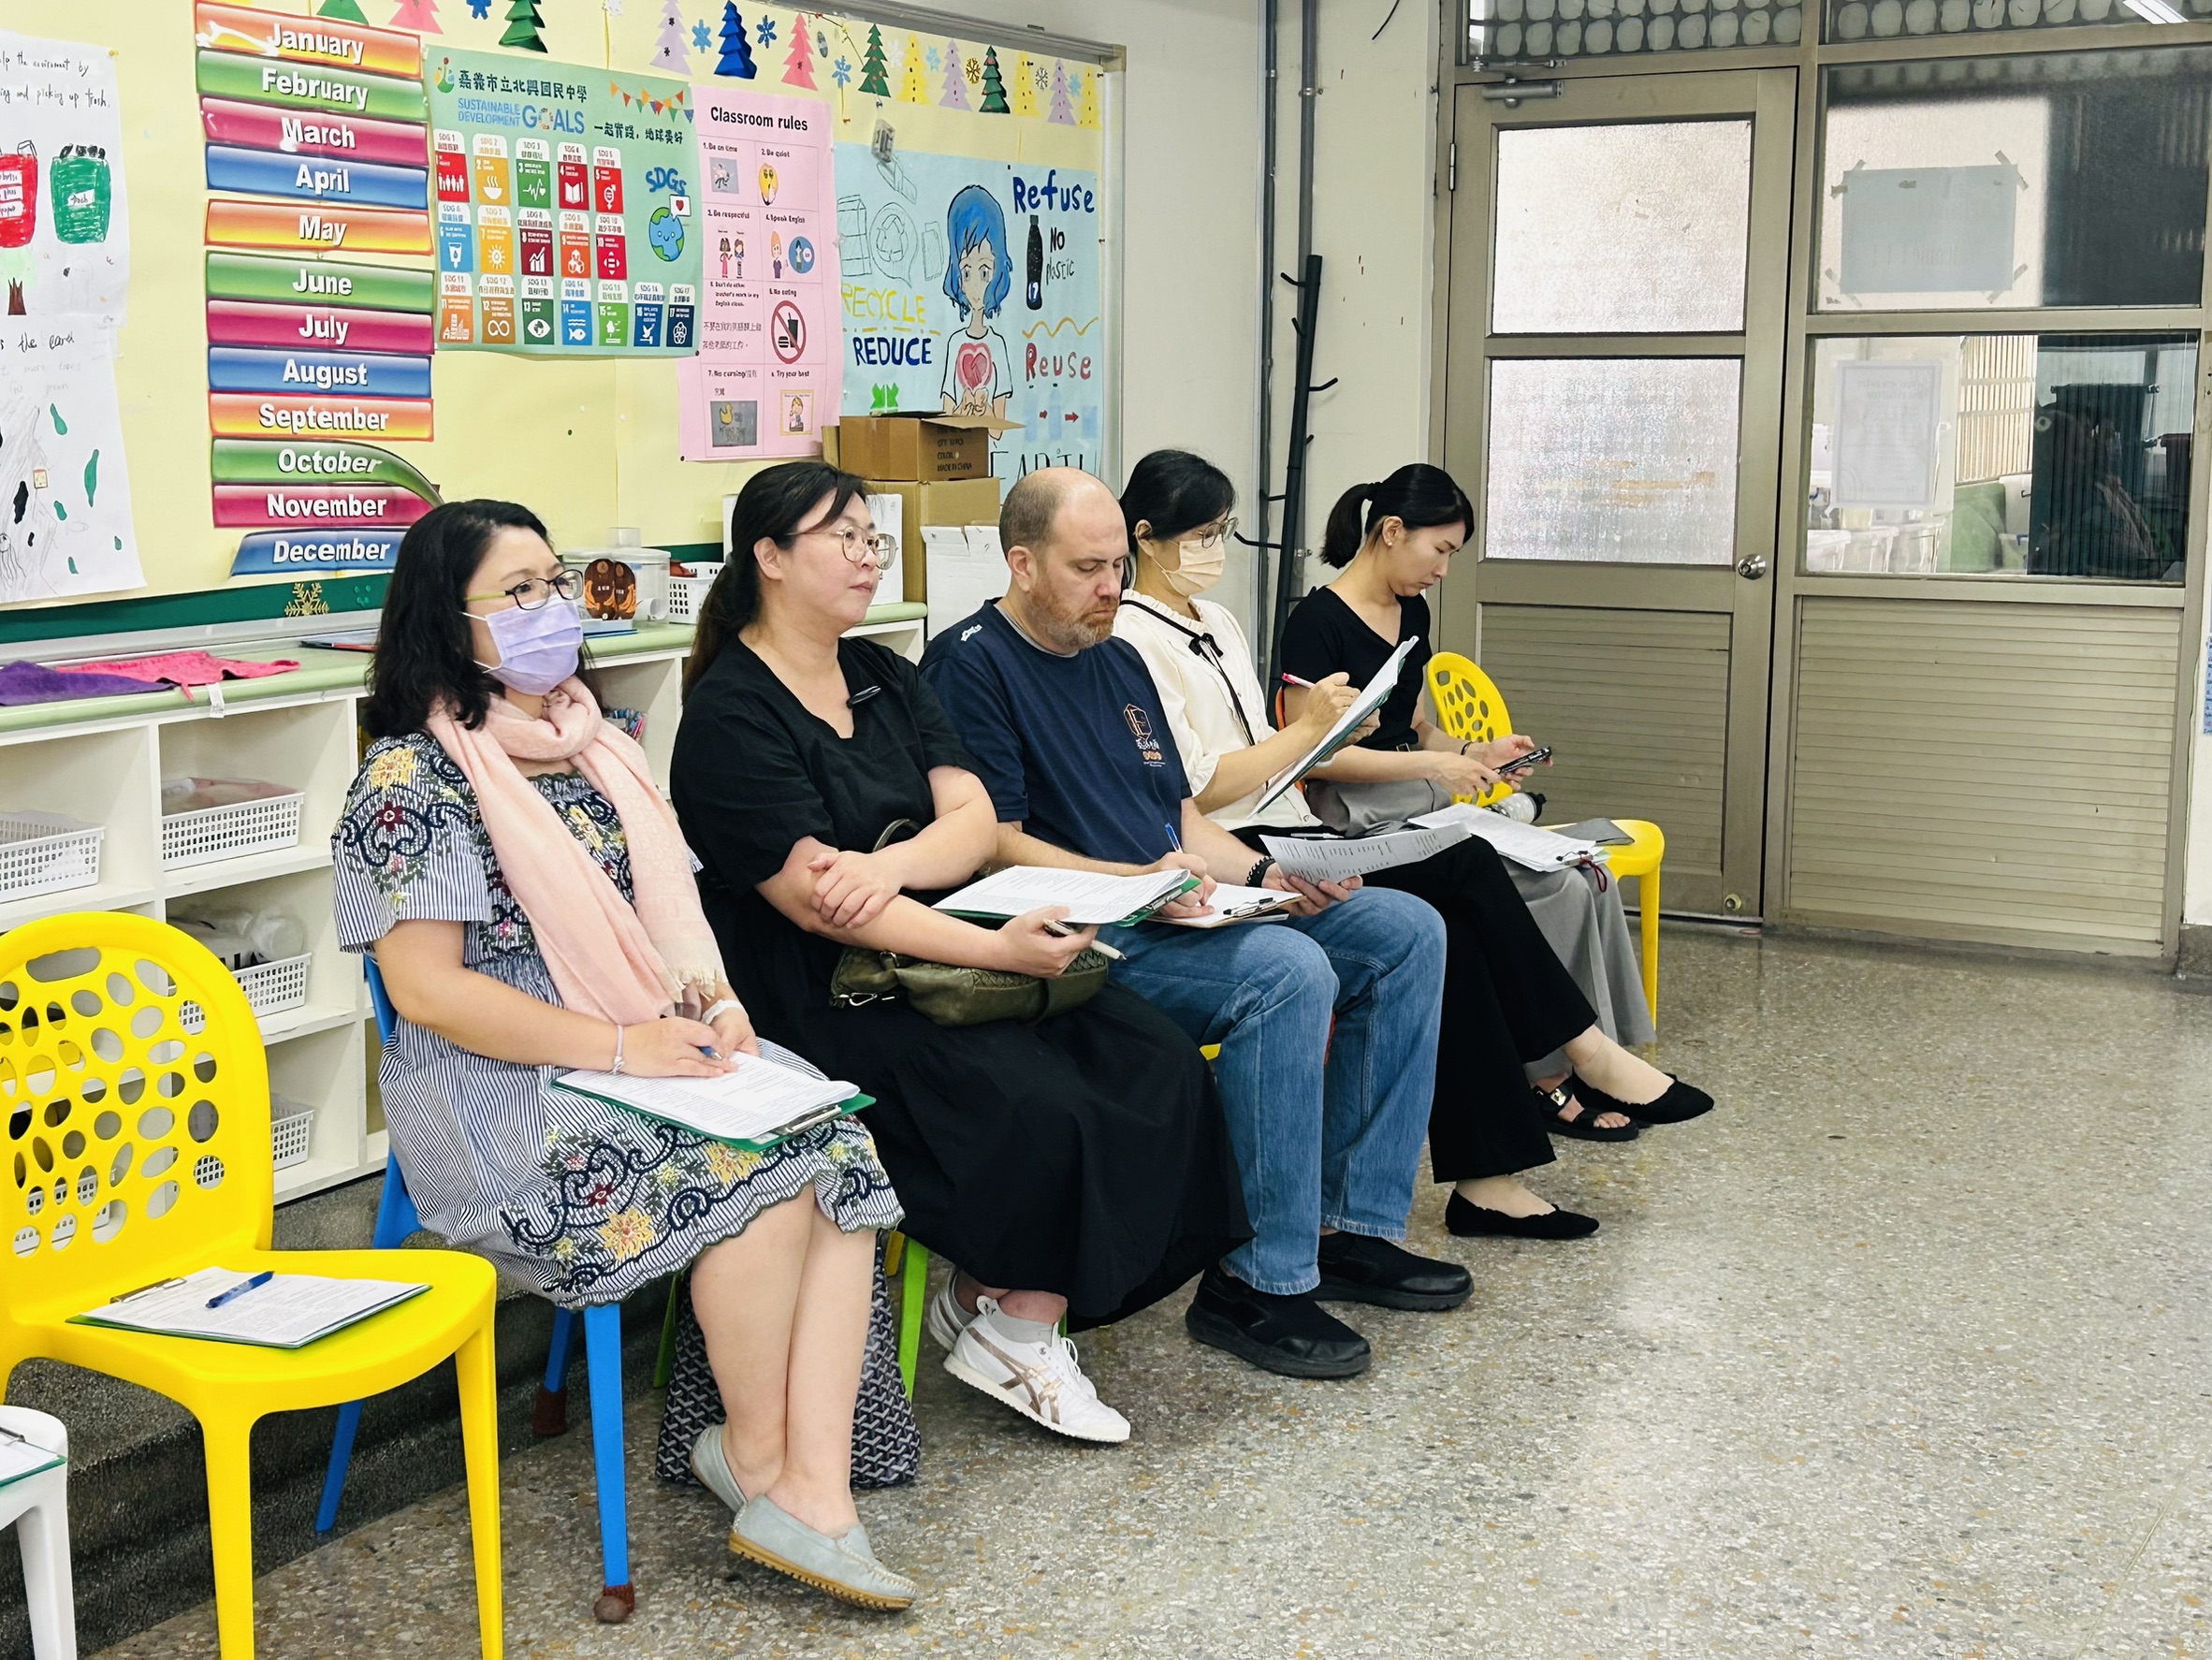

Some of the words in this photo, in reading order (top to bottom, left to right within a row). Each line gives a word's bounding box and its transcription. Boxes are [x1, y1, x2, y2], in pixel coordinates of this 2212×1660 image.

[267, 23, 364, 65] January
[79, 61, 89, 77] by
[68, 94, 80, 109] up
[262, 66, 369, 110] February
[458, 98, 521, 115] SUSTAINABLE
[458, 111, 521, 127] DEVELOPMENT
[521, 105, 585, 135] GOALS
[711, 107, 773, 127] Classroom
[779, 115, 808, 131] rules
[281, 117, 357, 149] March
[438, 133, 451, 142] SDG
[295, 164, 351, 196] April
[646, 167, 687, 197] SDGs
[1012, 169, 1095, 214] Refuse
[299, 214, 347, 246] May
[1050, 226, 1065, 254] NO
[292, 269, 353, 296] June
[840, 282, 926, 325] RECYCLE
[18, 332, 37, 353] the
[298, 313, 349, 345] July
[852, 337, 933, 366] REDUCE
[1026, 342, 1093, 382] Reuse
[283, 358, 368, 390] August
[259, 403, 389, 434] September
[278, 448, 383, 474] October
[267, 494, 387, 518] November
[273, 538, 391, 563] December
